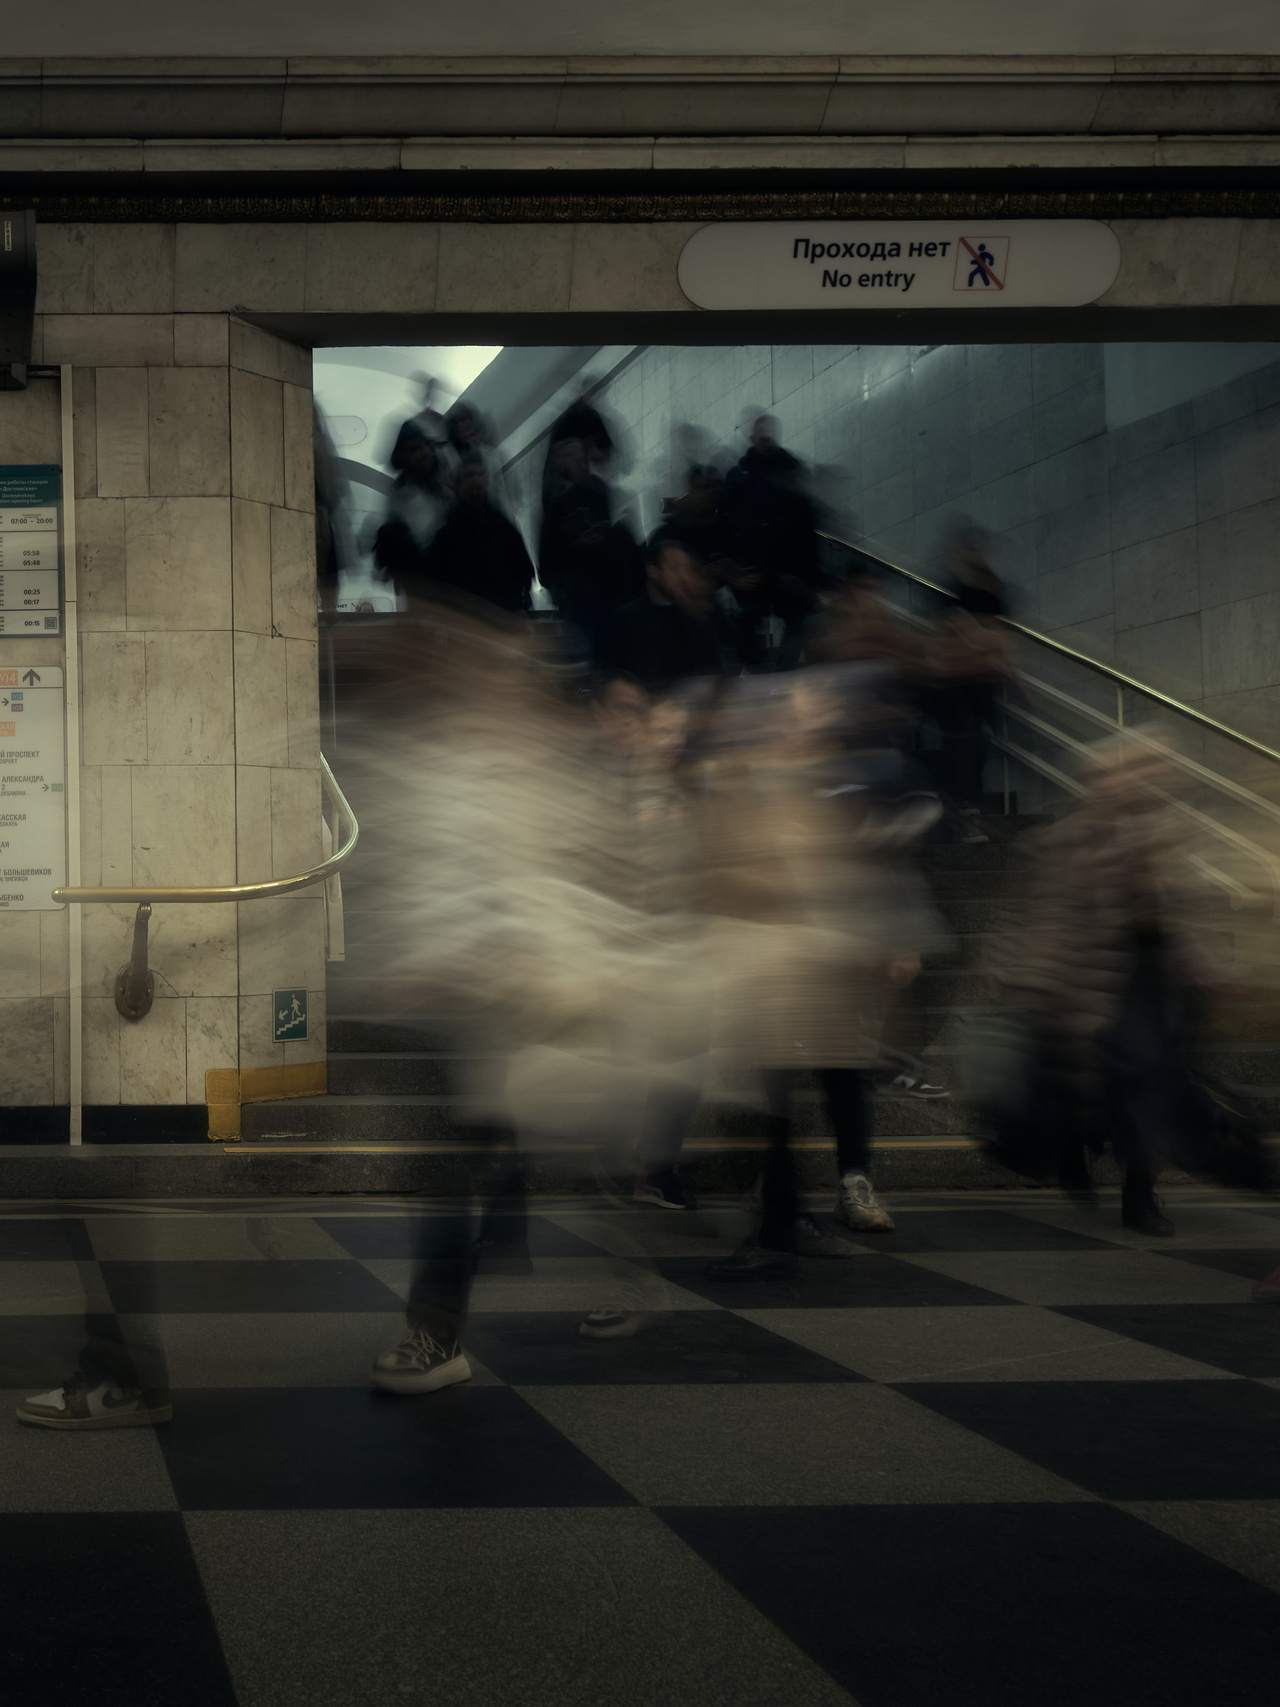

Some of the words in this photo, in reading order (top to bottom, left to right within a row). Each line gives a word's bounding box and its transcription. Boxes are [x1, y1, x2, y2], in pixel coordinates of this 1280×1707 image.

[793, 238, 901, 264] Прохода
[908, 242, 951, 257] нет
[822, 269, 852, 287] No
[858, 270, 916, 292] entry
[2, 775, 44, 783] АЛЕКСАНДРА
[3, 868, 52, 876] БОЛЬШЕВИКОВ
